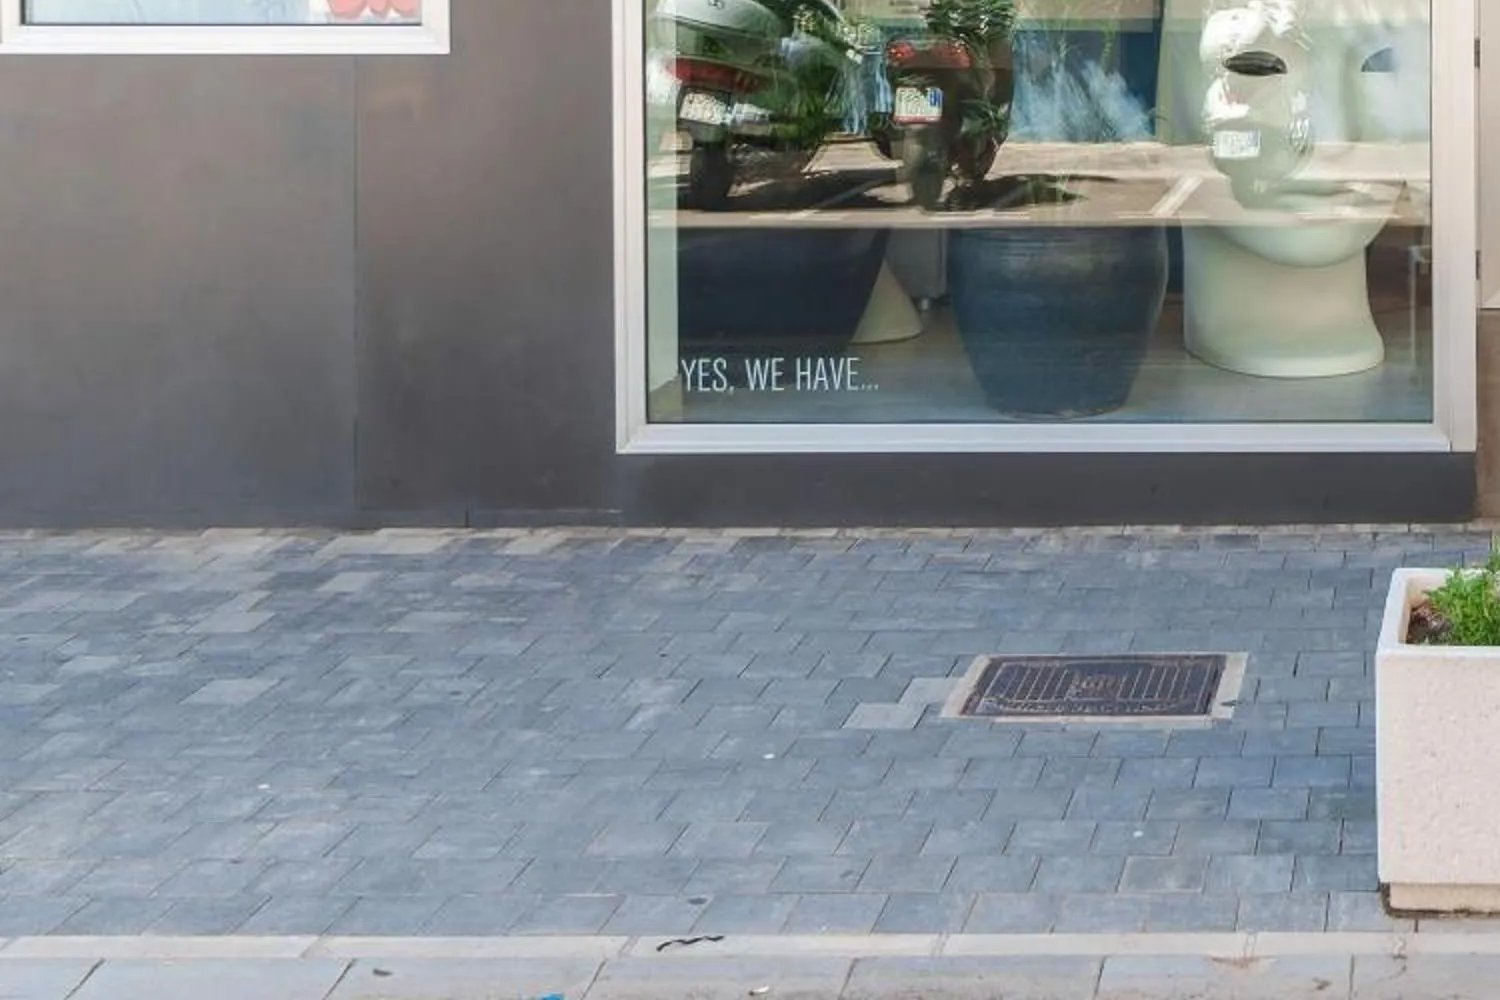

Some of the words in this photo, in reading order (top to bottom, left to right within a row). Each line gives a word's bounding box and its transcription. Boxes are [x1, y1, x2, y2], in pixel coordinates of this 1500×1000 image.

[681, 356, 735, 396] YES,
[744, 356, 785, 393] WE
[795, 356, 880, 393] HAVE...
